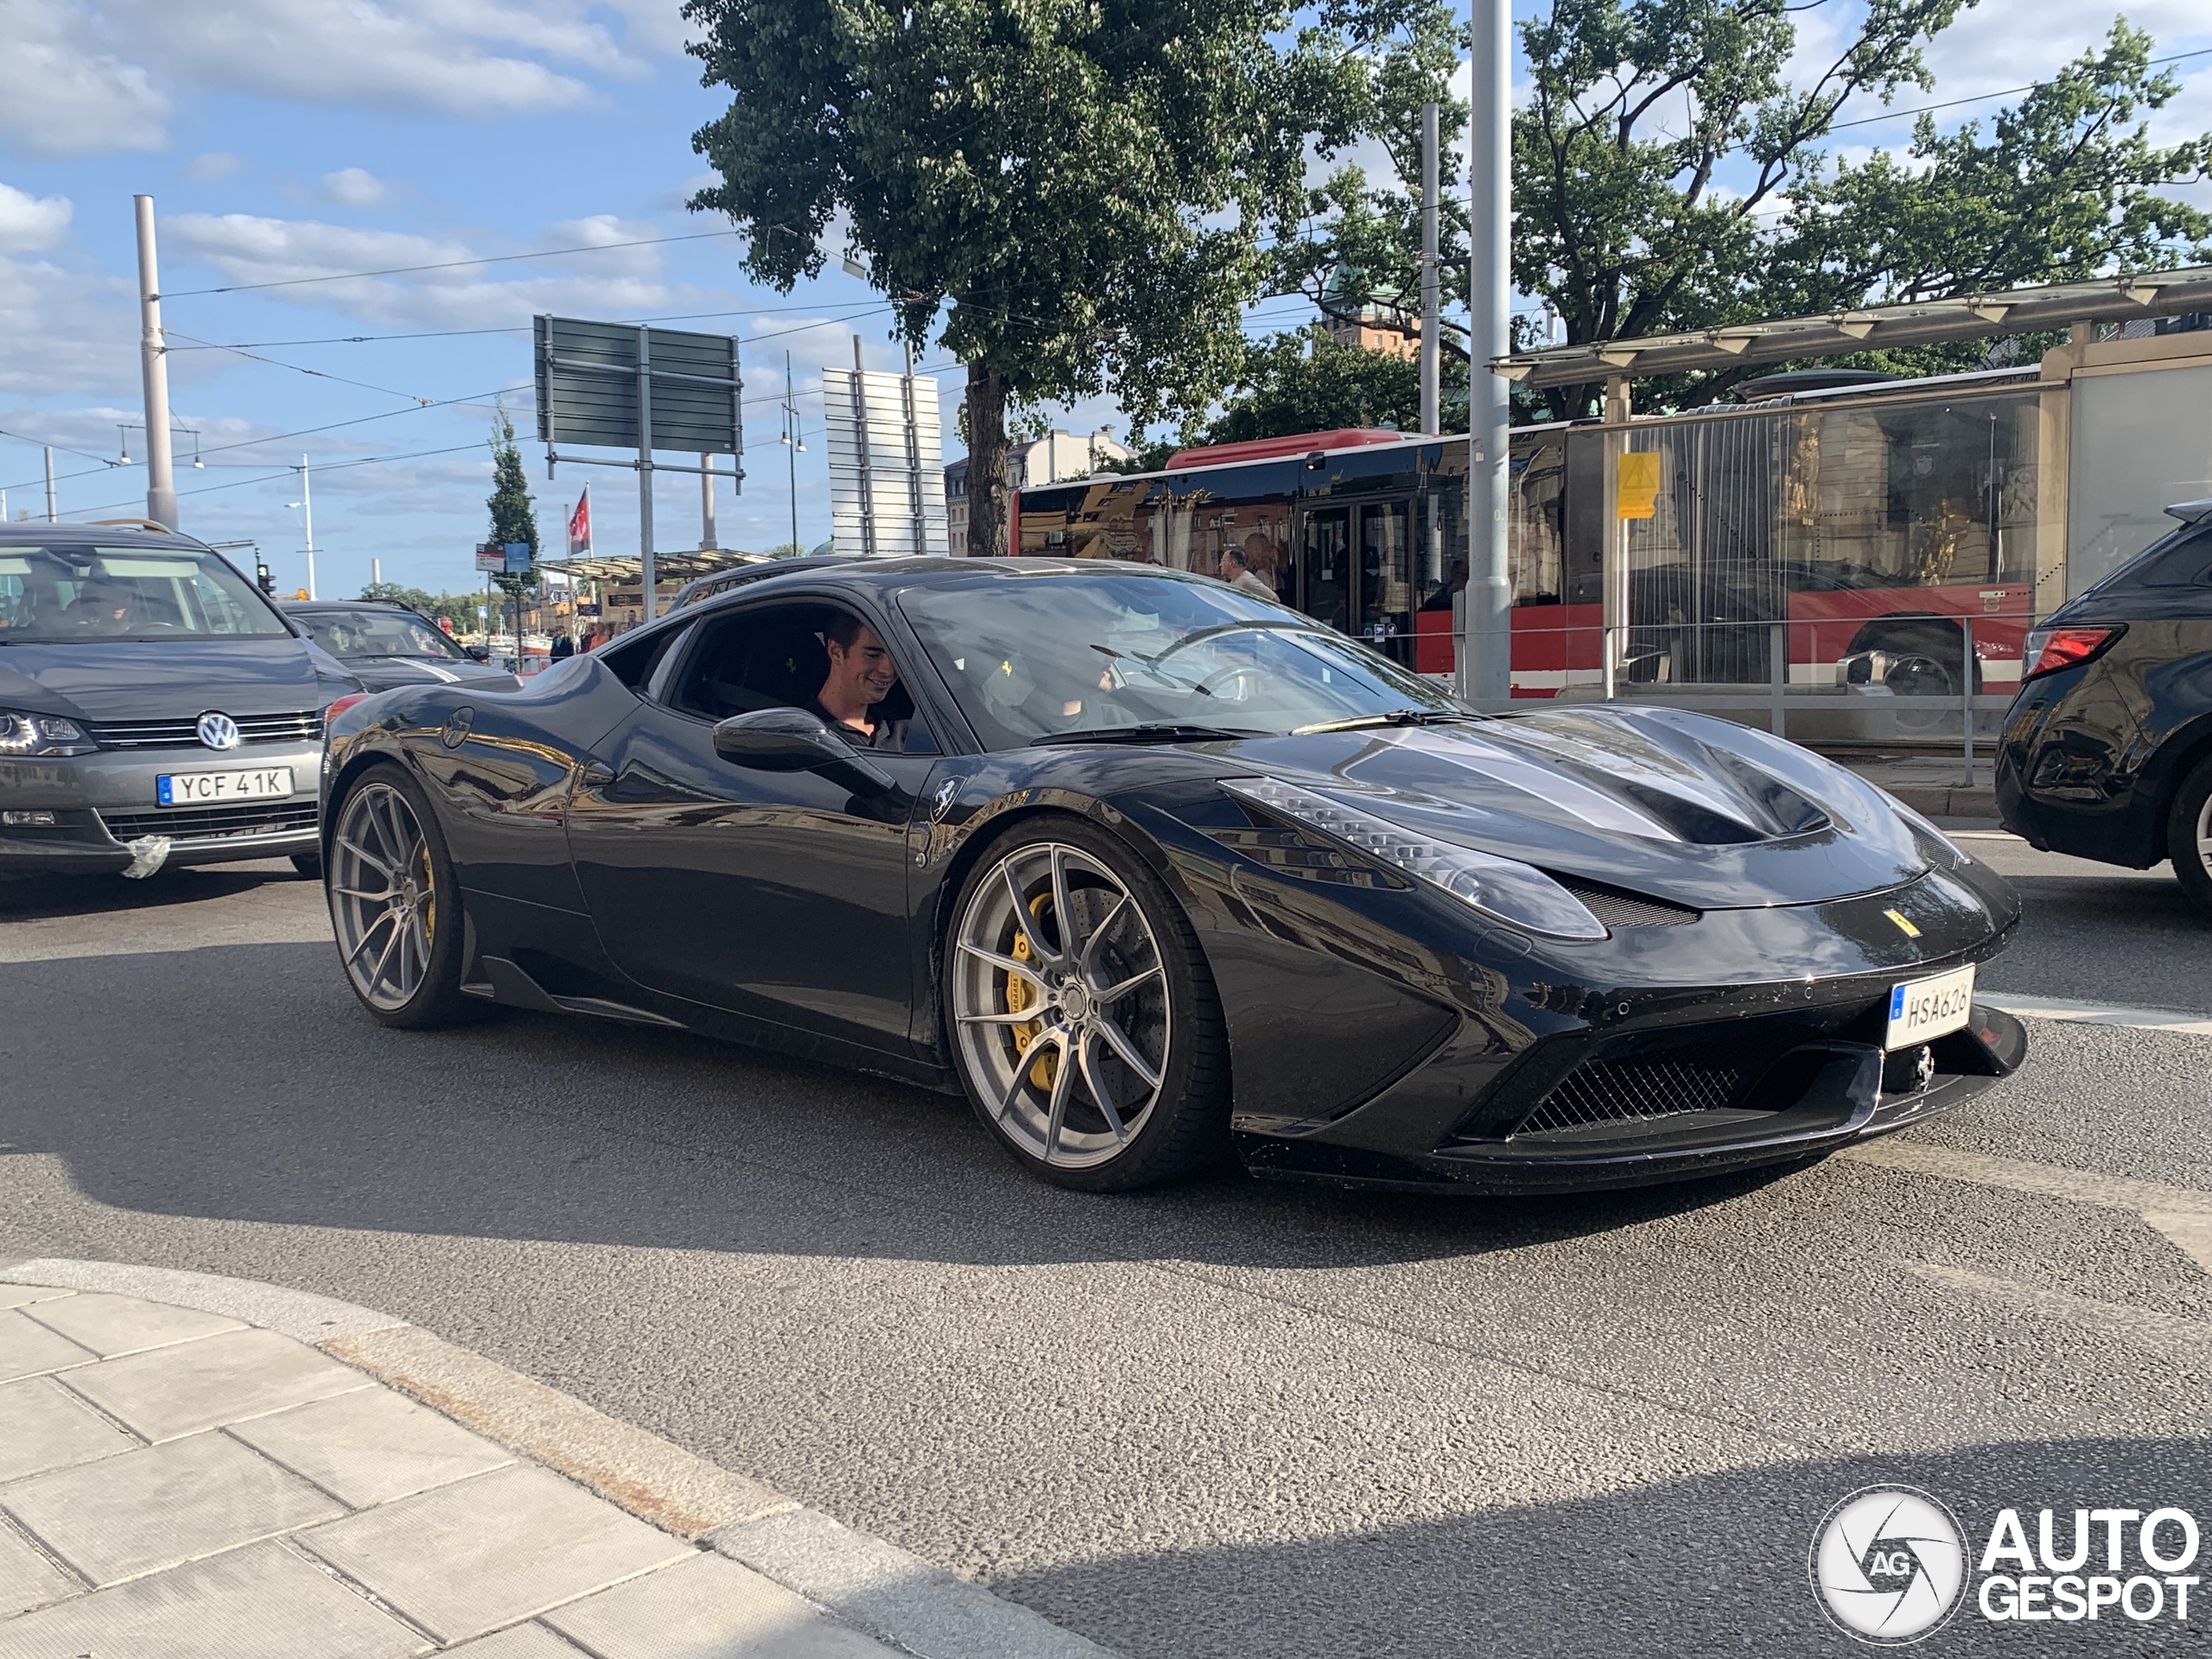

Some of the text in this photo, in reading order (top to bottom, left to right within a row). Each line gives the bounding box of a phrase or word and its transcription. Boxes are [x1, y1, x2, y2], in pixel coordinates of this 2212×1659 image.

[181, 772, 281, 798] YCF 41K
[1894, 1007, 1900, 1018] S
